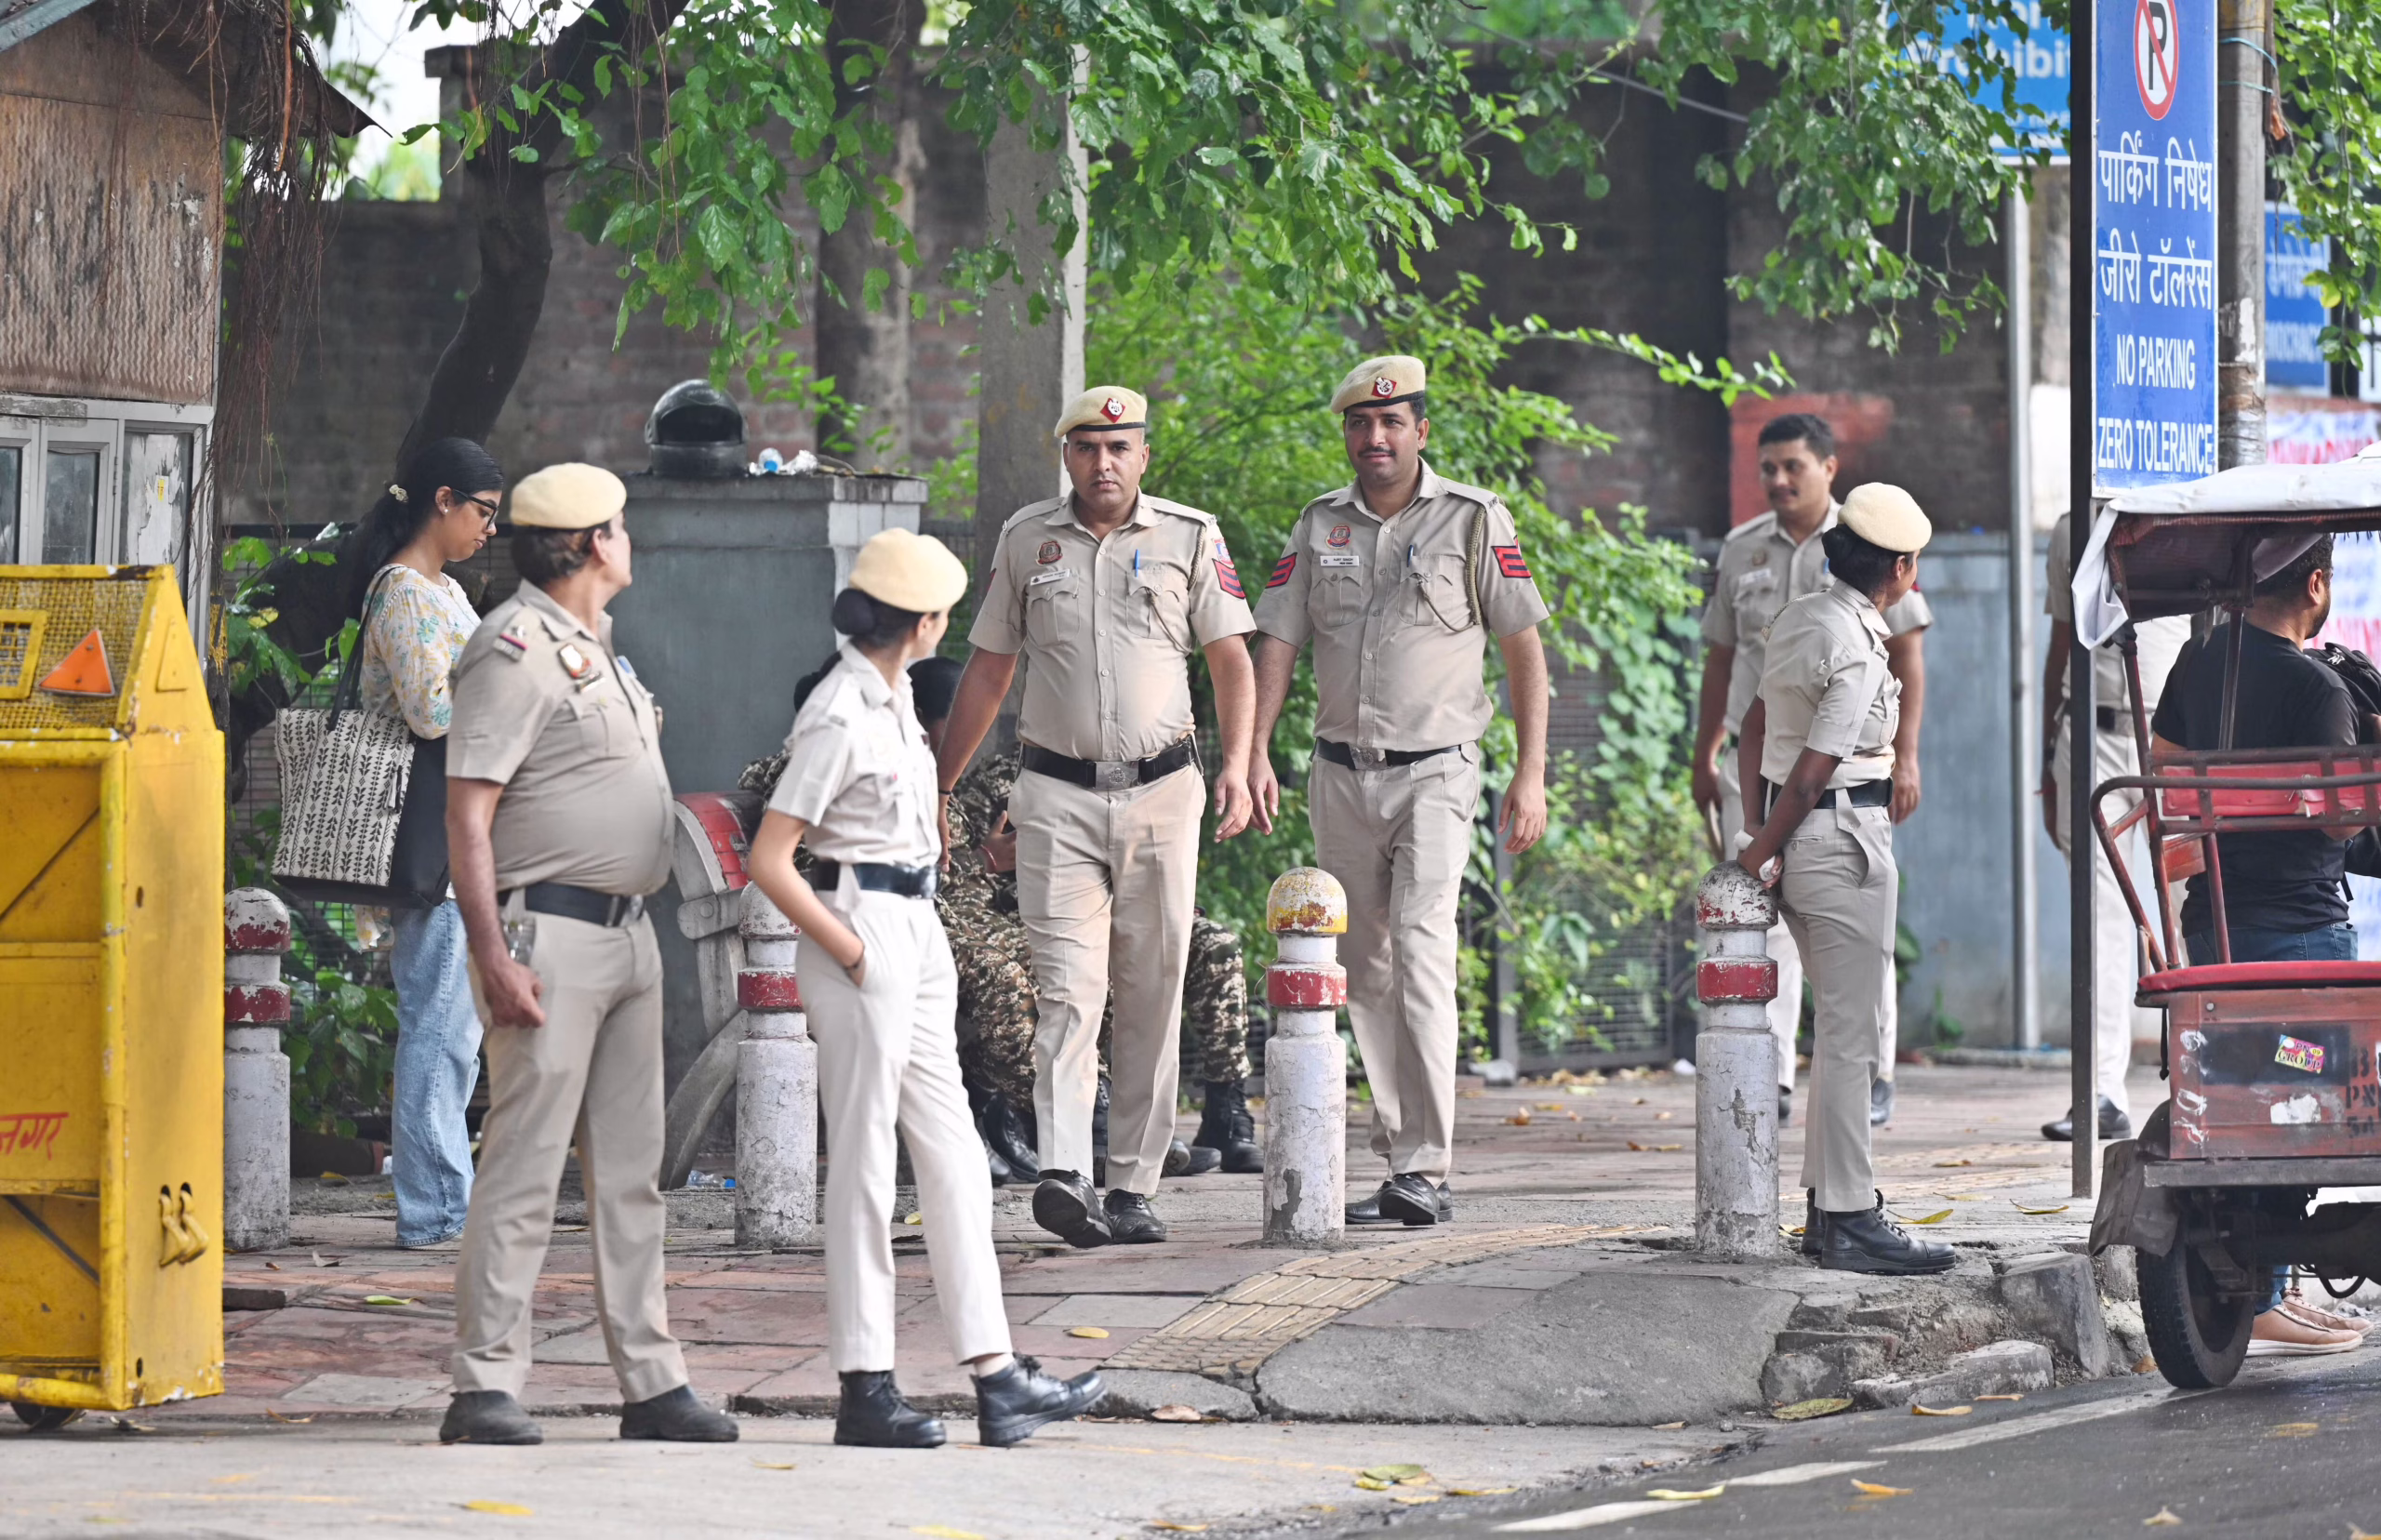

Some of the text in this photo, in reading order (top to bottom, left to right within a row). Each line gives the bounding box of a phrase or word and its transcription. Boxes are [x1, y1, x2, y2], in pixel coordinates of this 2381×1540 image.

[2098, 130, 2214, 213] पार्किंग निषेध
[2097, 228, 2142, 305] जीरो
[2147, 235, 2214, 311] टॉलरेंस
[2116, 333, 2196, 391] NO PARKING
[2097, 417, 2134, 471] ZERO
[2135, 419, 2214, 474] TOLERANCE
[2278, 1051, 2321, 1069] GROUP
[2295, 1042, 2310, 1054] PN
